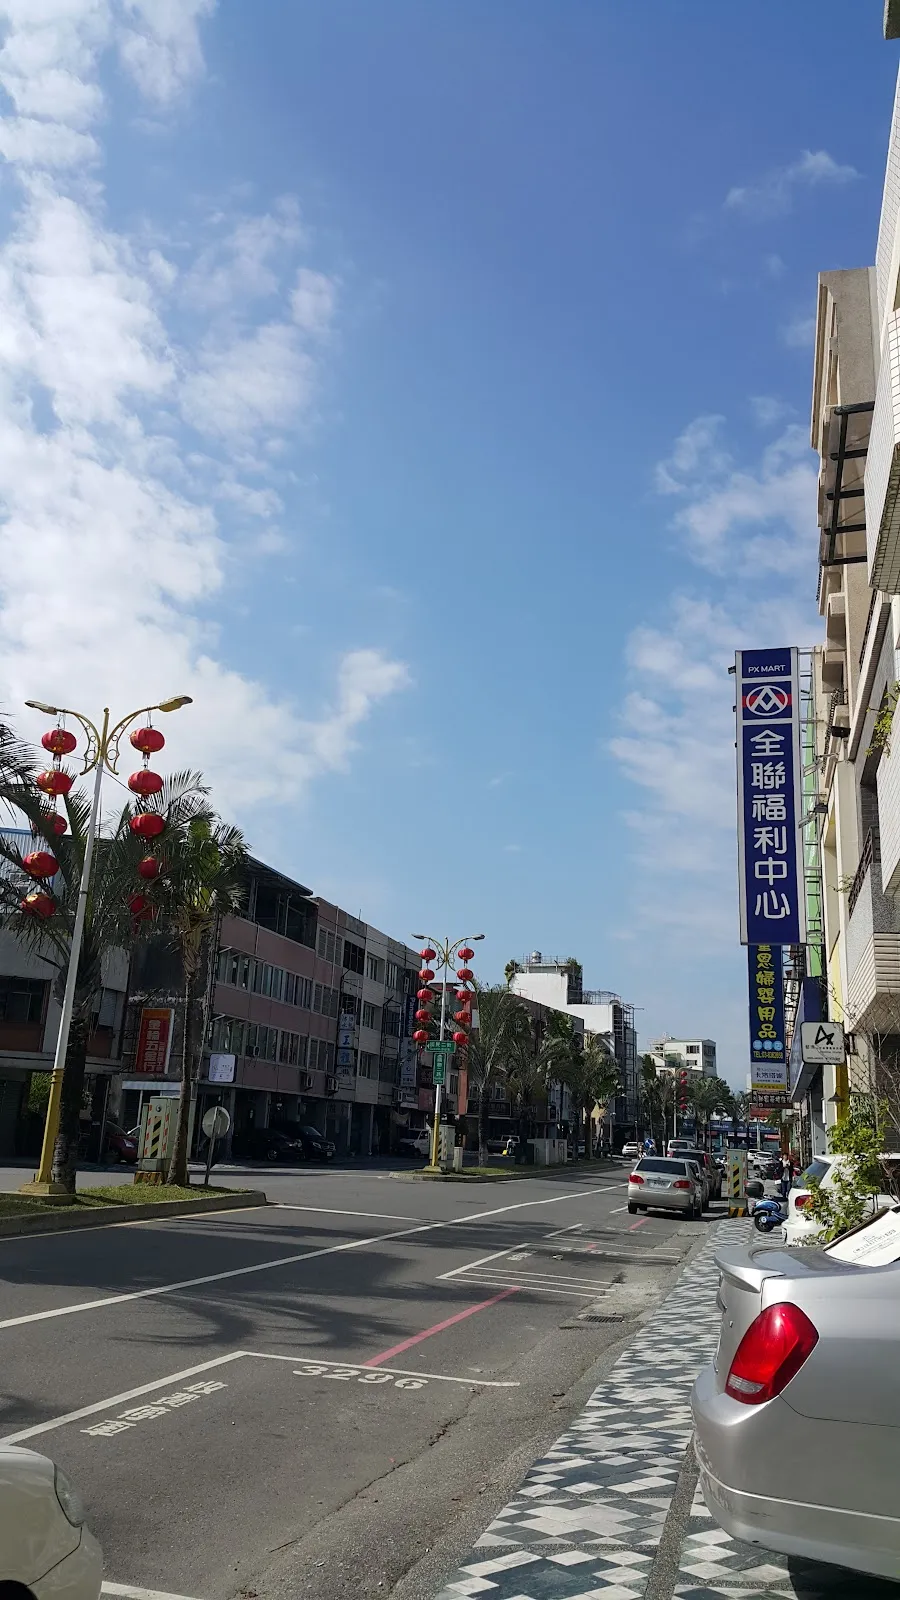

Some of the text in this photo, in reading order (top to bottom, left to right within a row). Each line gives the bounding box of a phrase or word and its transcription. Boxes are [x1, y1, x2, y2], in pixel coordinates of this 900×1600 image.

[748, 664, 786, 674] PX MART
[750, 730, 791, 920] 全聯福利中心
[292, 1365, 430, 1390] 3296
